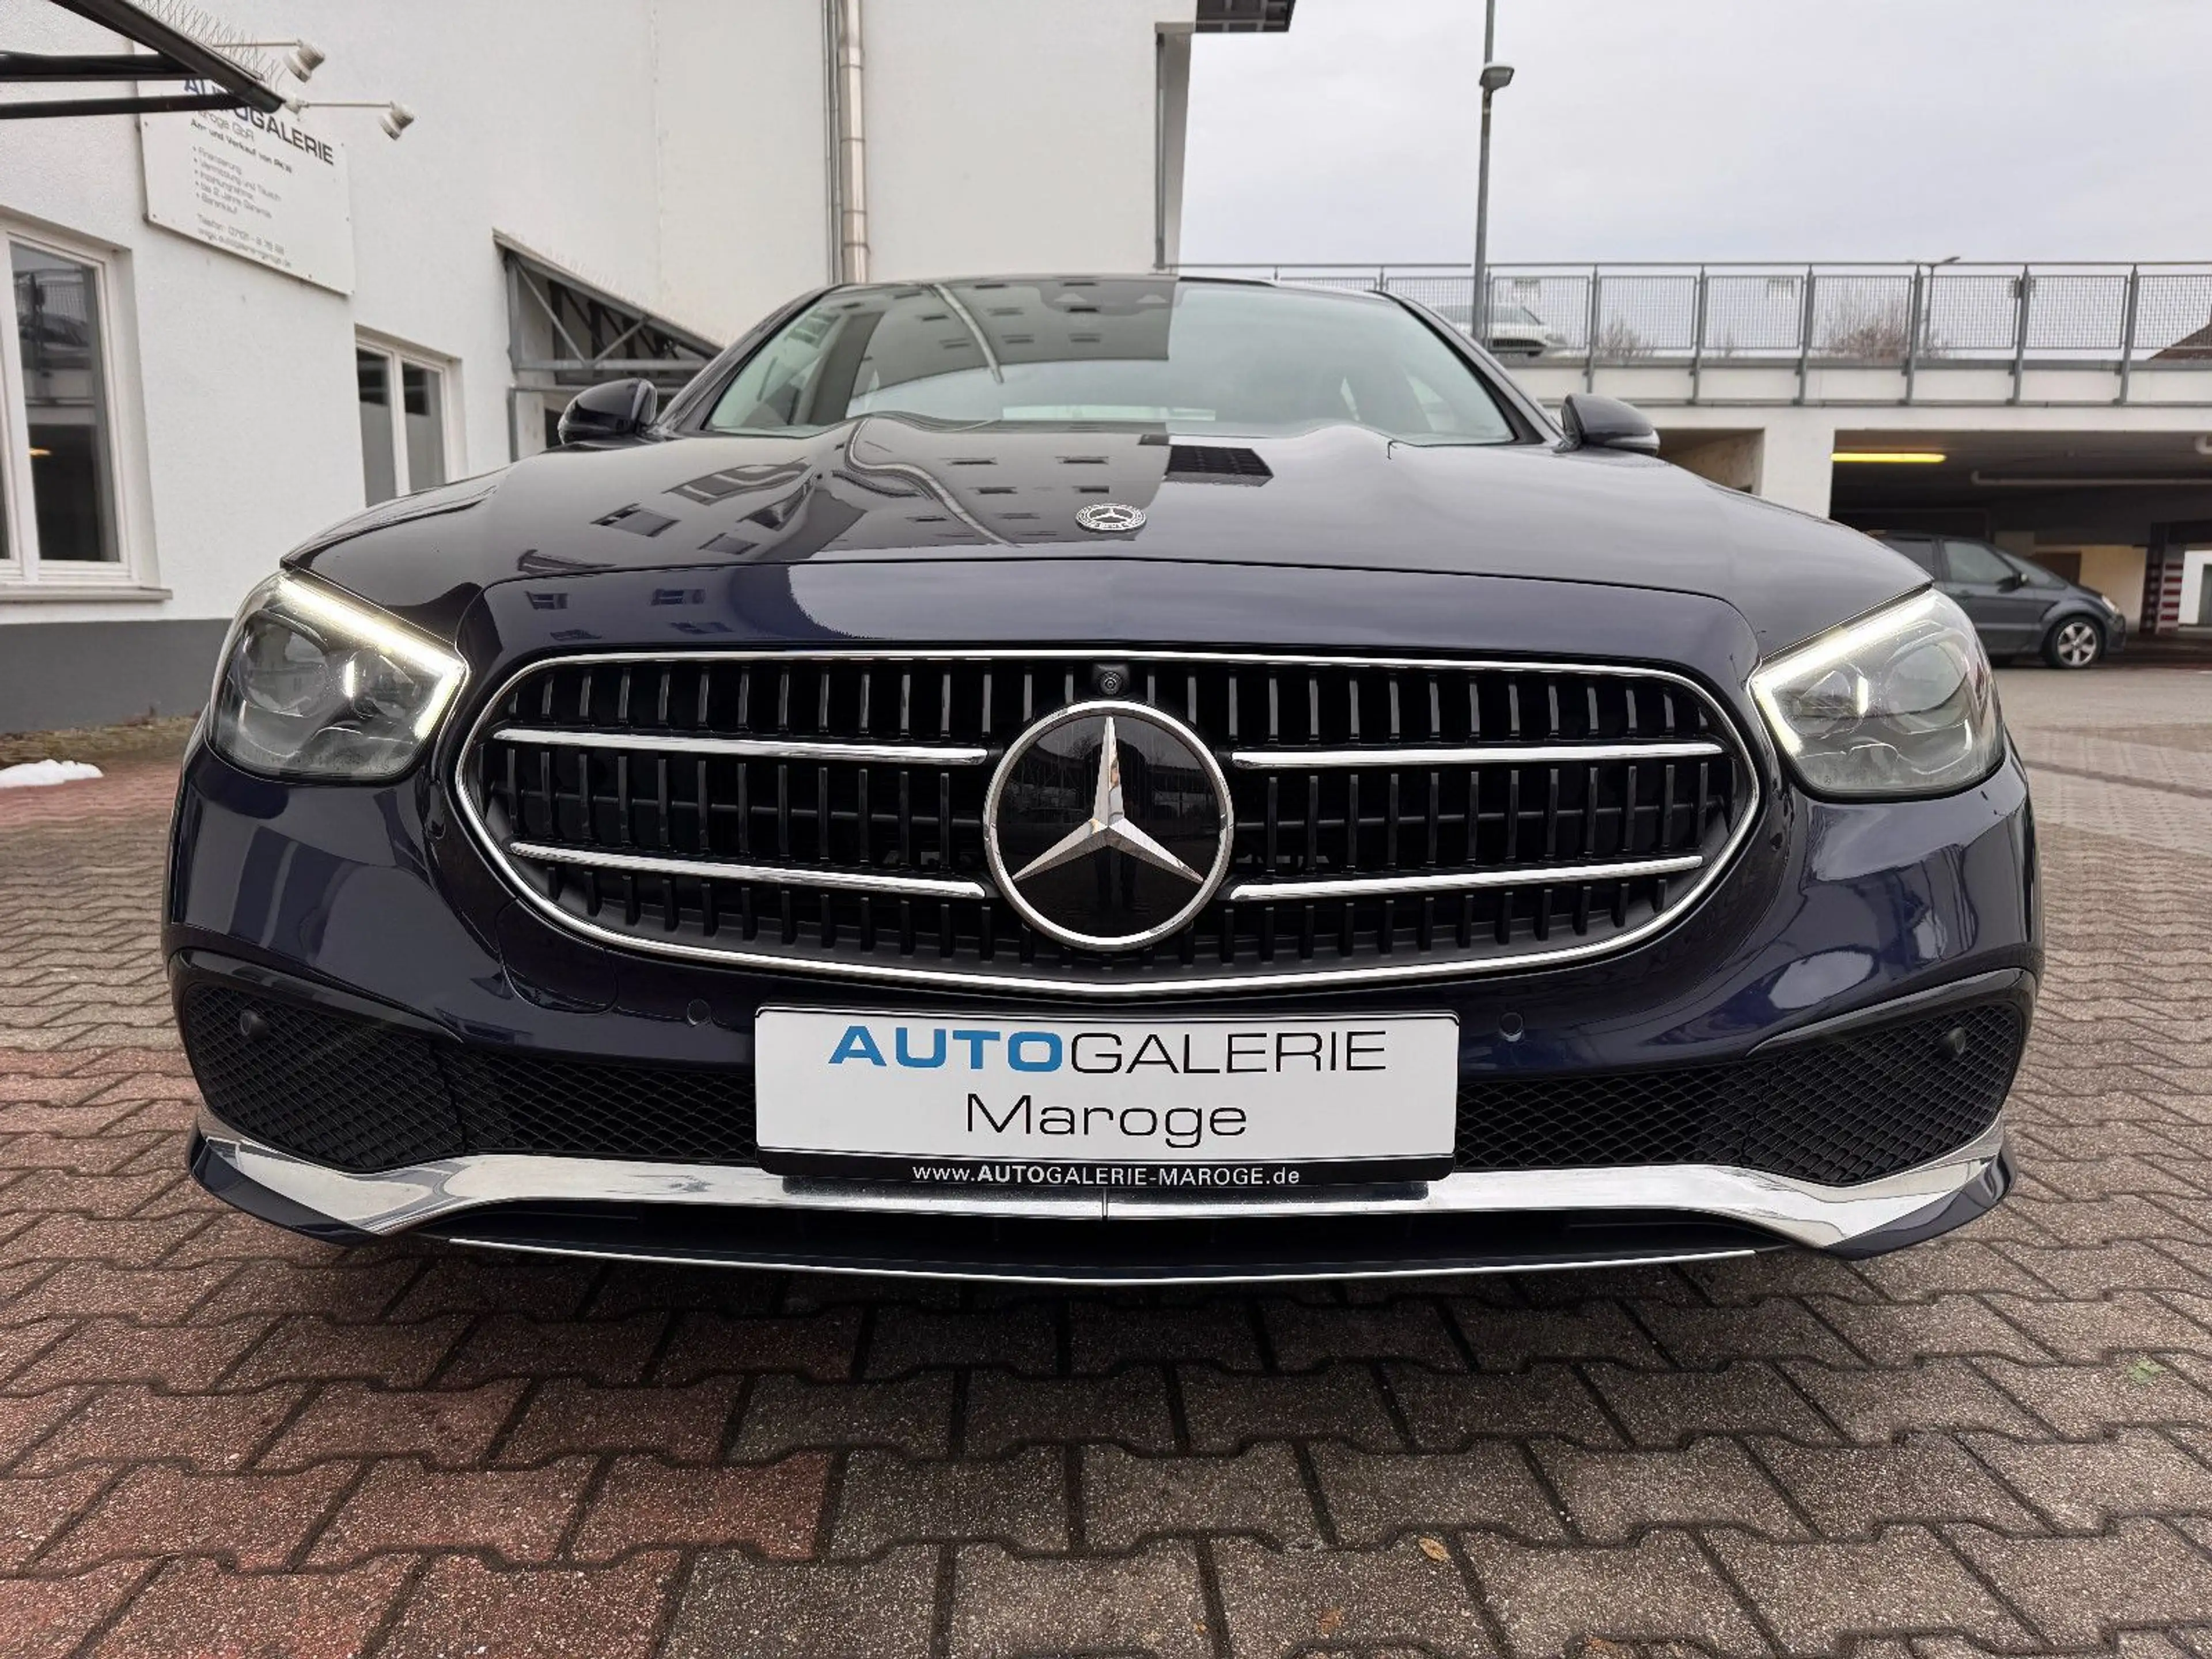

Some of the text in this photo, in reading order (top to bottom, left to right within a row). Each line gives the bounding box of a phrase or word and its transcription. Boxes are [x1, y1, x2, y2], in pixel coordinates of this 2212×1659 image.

[184, 79, 334, 166] AOGALERIE
[827, 1025, 1387, 1074] AUTOGALERIE
[967, 1092, 1247, 1149] Maroge
[912, 1165, 1301, 1185] www.AUTOGALERIE-MAROGE.de
